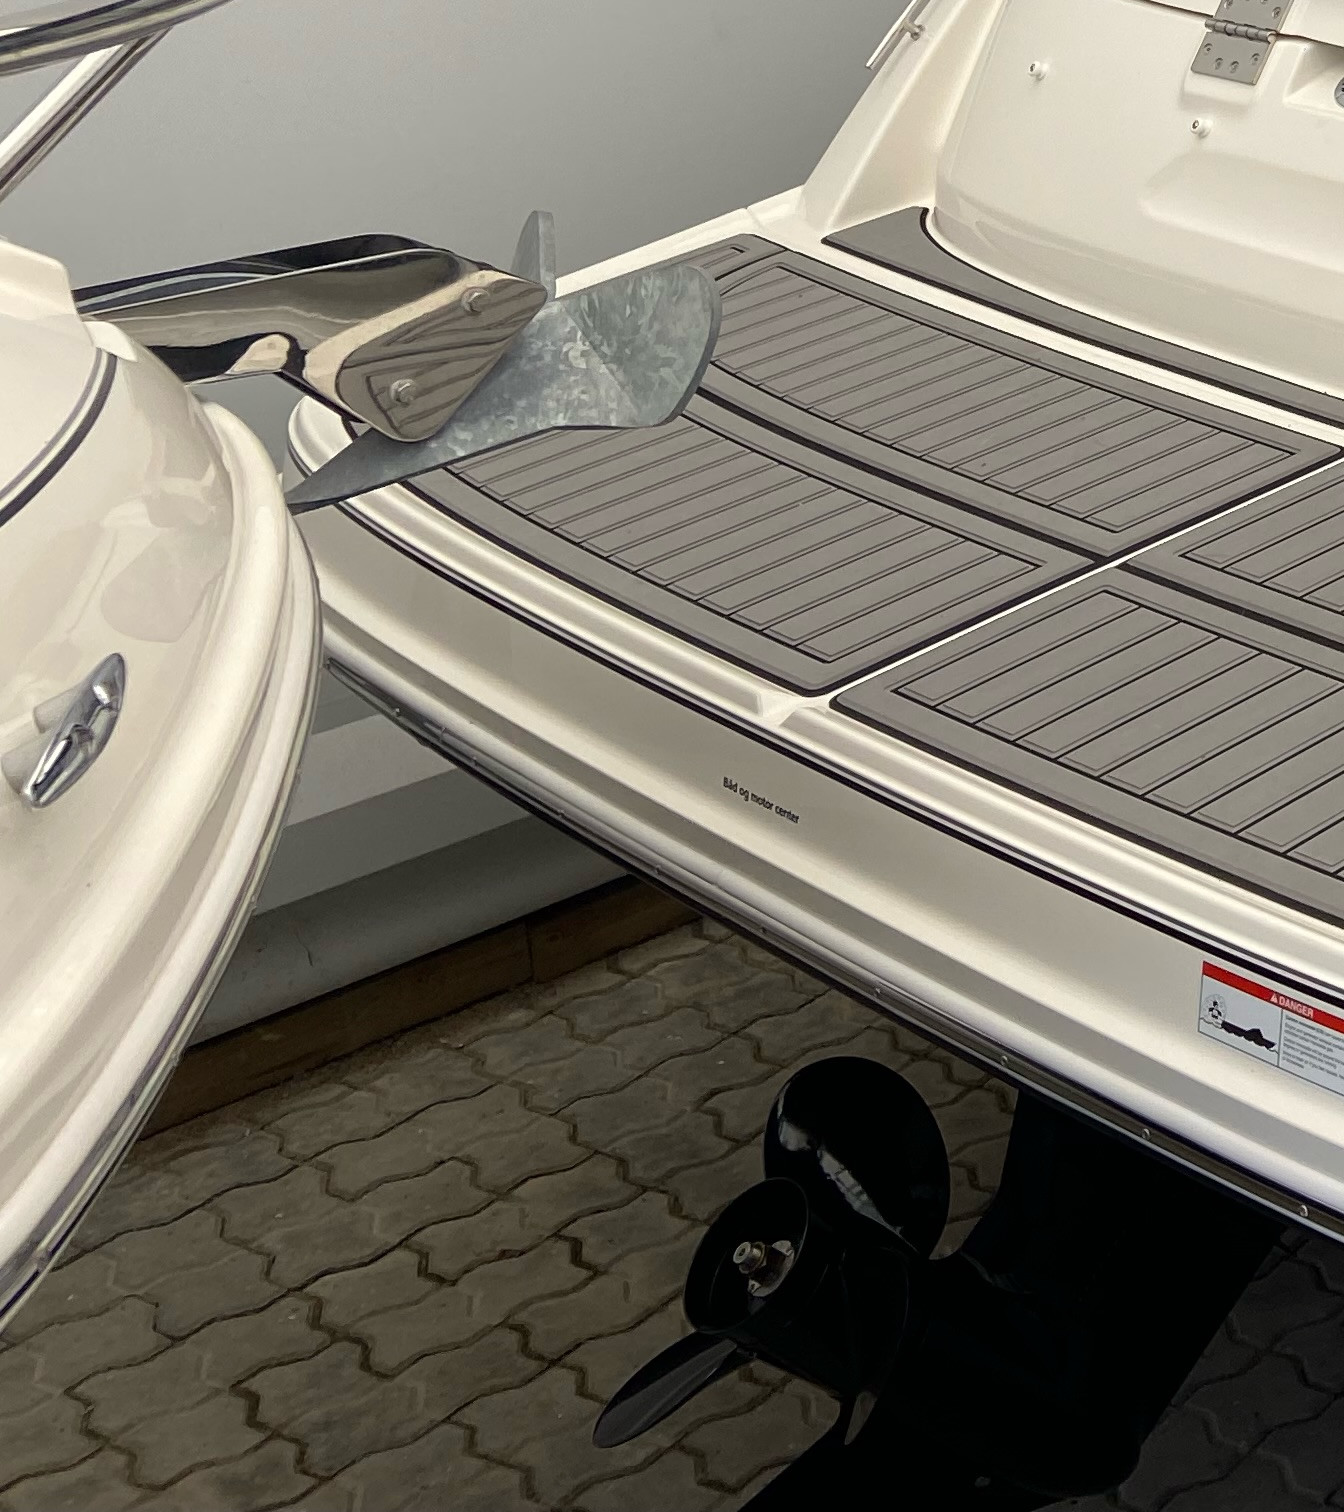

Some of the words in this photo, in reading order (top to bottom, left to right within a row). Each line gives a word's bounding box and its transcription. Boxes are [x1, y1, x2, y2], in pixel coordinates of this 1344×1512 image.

[739, 787, 749, 802] og
[750, 792, 774, 810] motor
[775, 805, 799, 823] center
[1279, 995, 1314, 1019] DANGER
